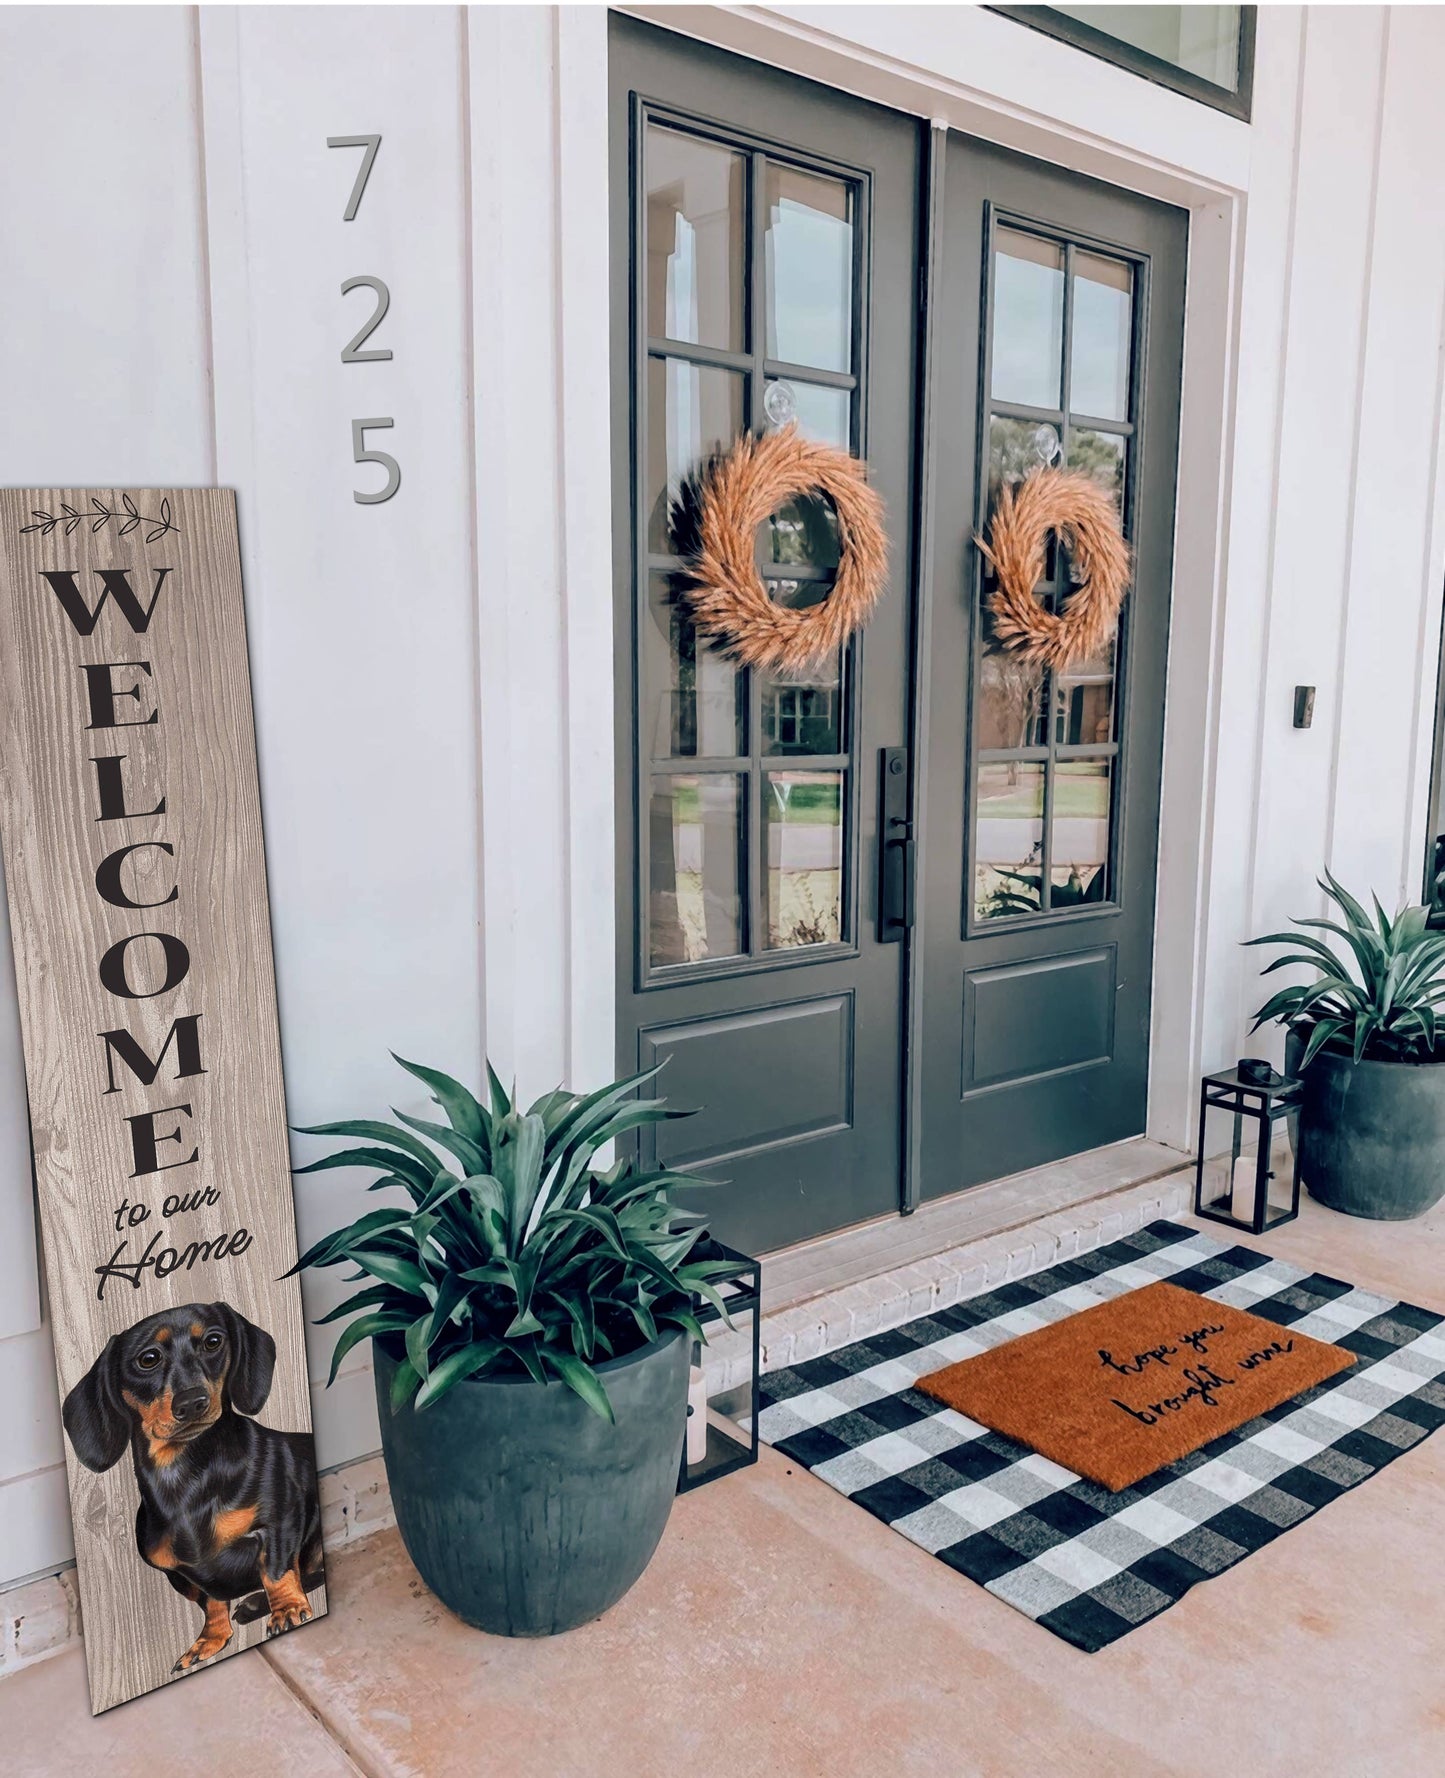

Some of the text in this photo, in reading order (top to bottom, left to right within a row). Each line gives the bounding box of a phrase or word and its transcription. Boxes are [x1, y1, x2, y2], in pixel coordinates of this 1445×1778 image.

[38, 567, 208, 1178] WELCOME
[114, 1185, 221, 1231] to our
[95, 1229, 253, 1301] Home
[1097, 1324, 1224, 1375] hope you
[1109, 1364, 1236, 1425] brought
